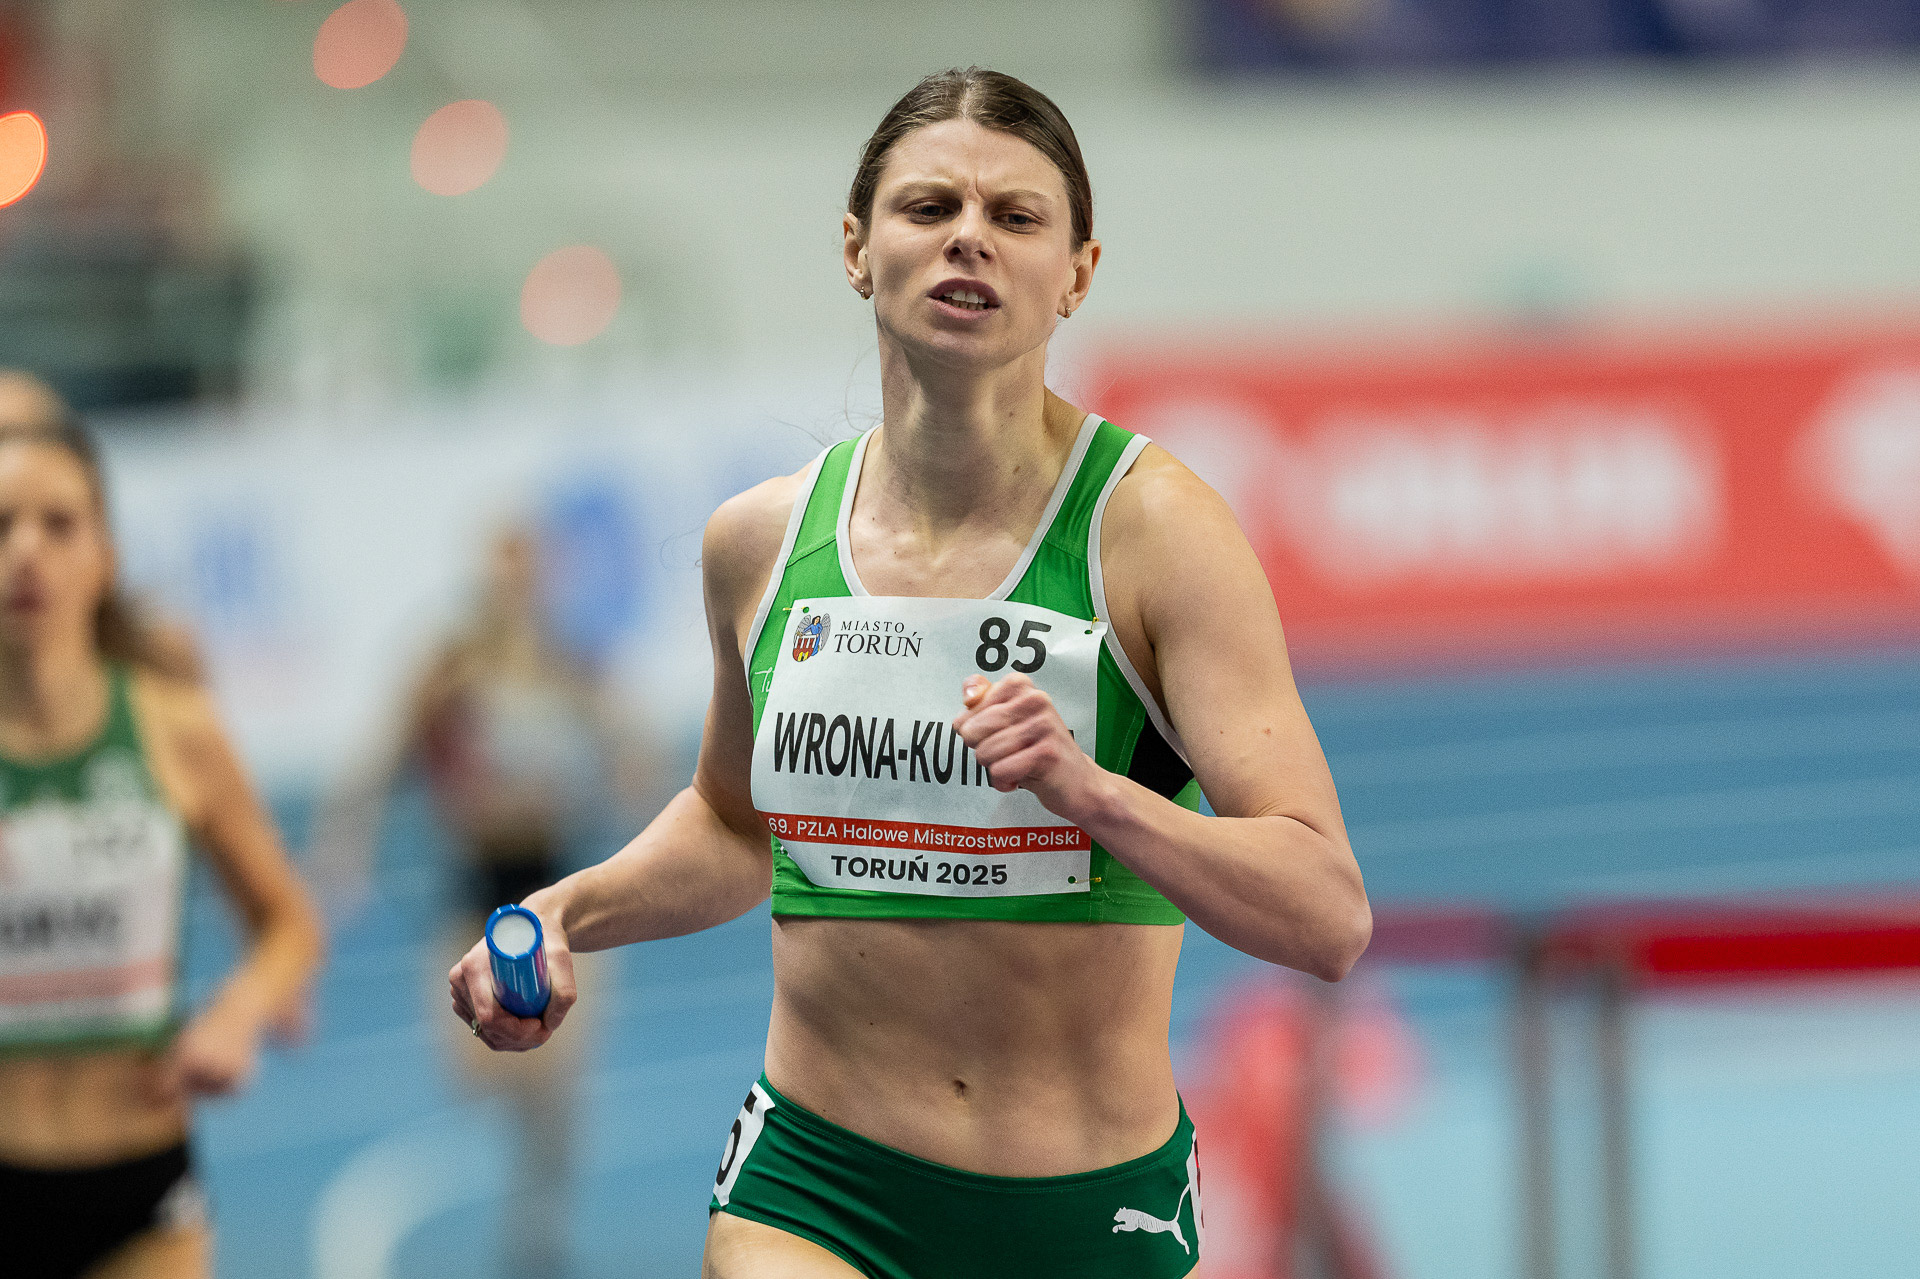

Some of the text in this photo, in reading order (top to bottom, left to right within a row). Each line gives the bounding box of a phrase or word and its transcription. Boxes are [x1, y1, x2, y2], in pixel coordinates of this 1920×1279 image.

[840, 620, 905, 633] MIASTO
[834, 632, 923, 658] TORUŃ
[975, 616, 1052, 673] 85
[774, 711, 1075, 789] WRONA-KU
[768, 817, 1080, 849] 69. PZLA Halowe Mistrzostwa Polski
[831, 854, 1008, 886] TORUŃ 2025
